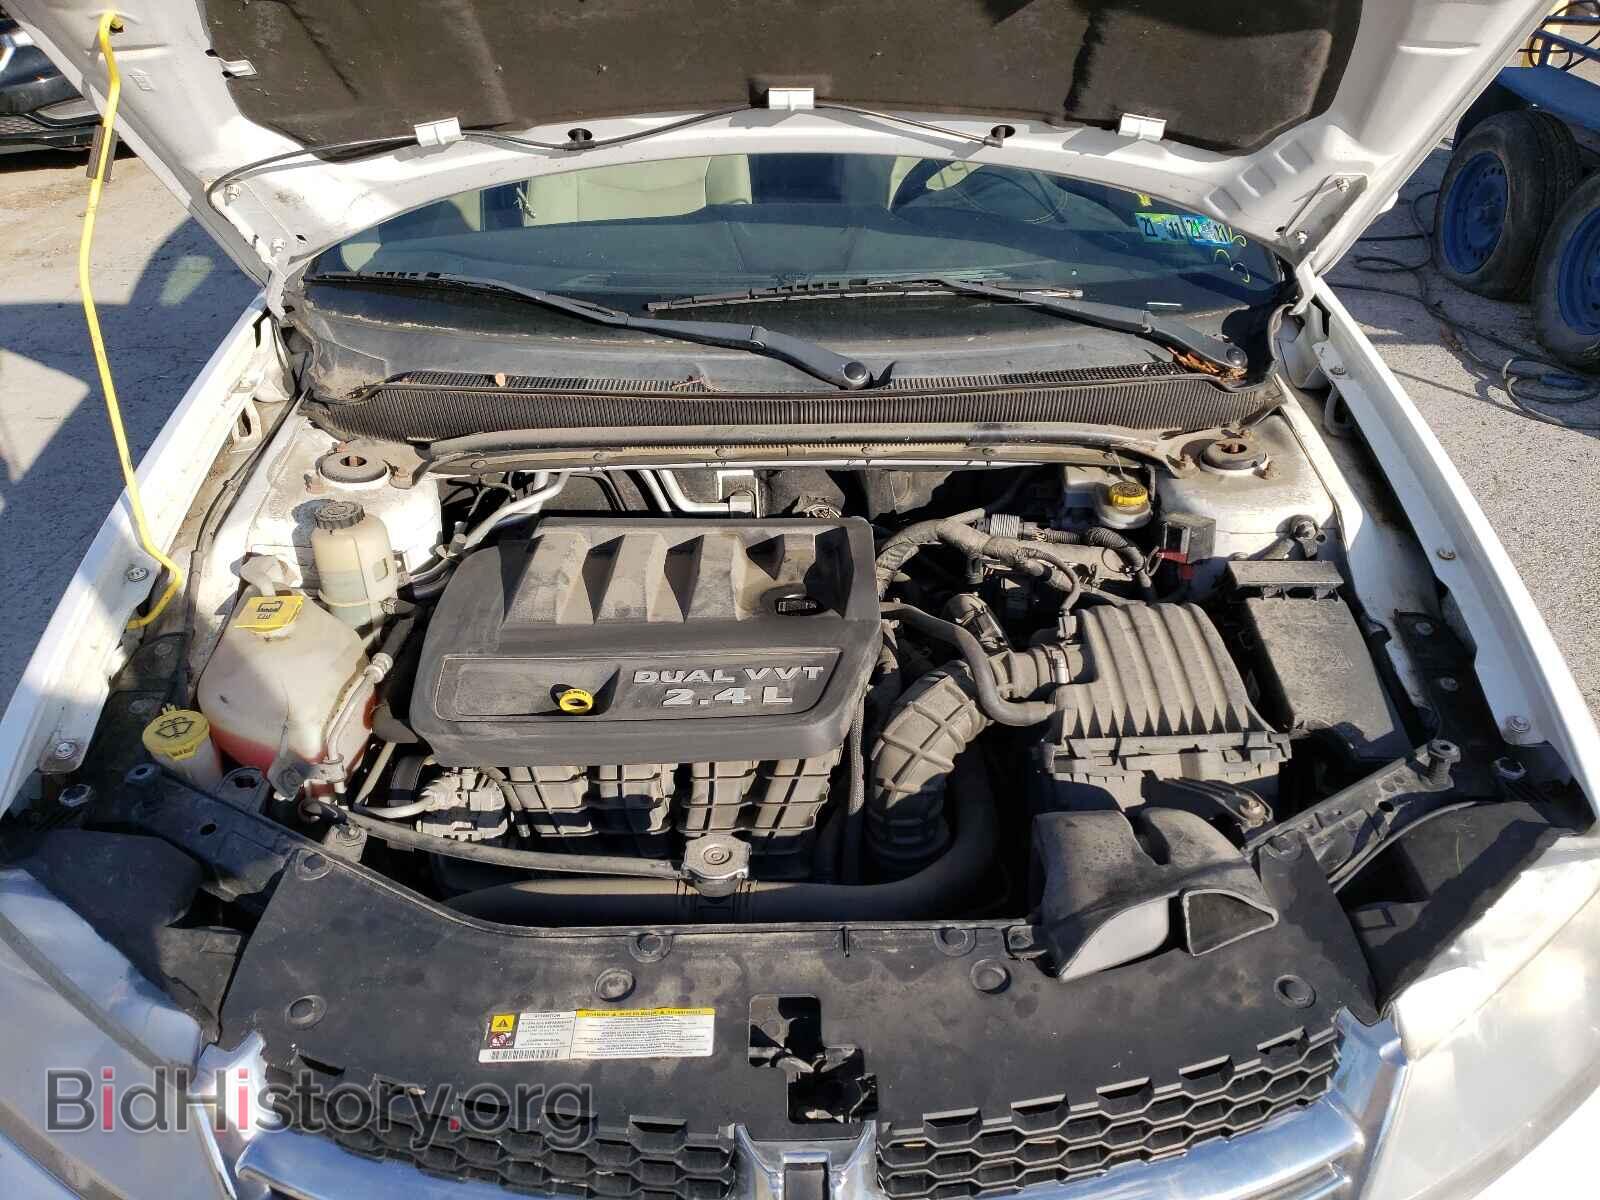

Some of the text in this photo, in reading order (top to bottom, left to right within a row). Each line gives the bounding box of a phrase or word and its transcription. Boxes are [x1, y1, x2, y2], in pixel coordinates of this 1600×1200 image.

[633, 666, 825, 684] DUAL VVT
[662, 686, 793, 707] 2.4 L
